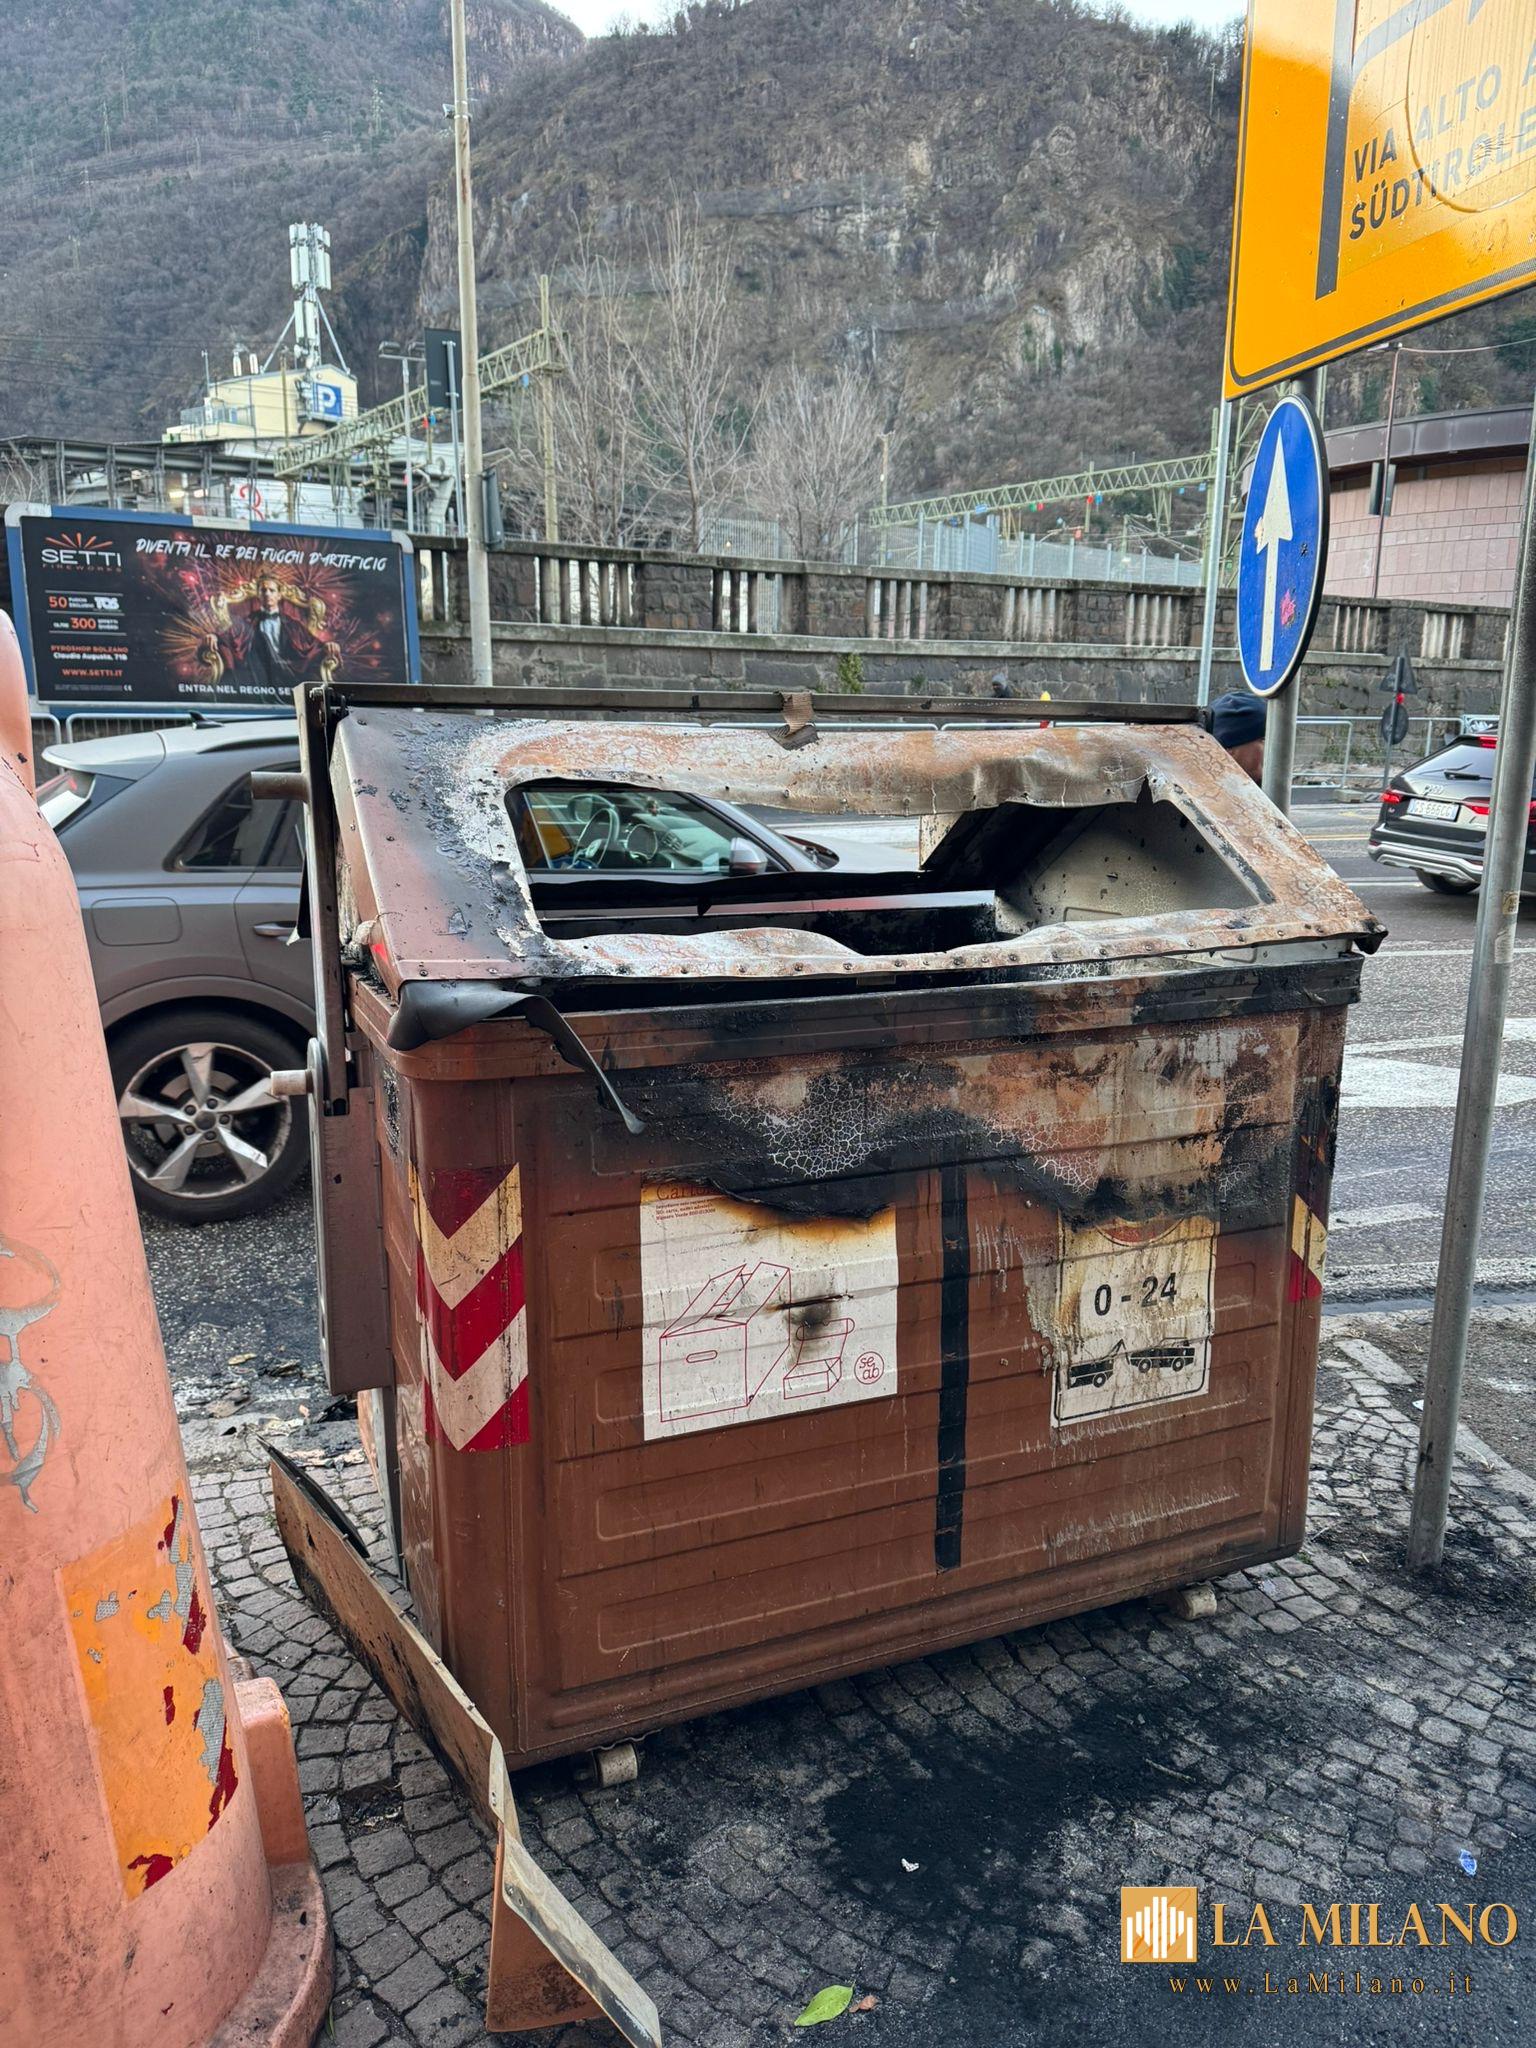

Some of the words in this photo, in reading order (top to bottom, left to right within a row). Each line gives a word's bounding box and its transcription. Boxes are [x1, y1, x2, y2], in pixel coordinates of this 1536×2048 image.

[1354, 128, 1397, 183] VIA
[1415, 64, 1502, 144] ALTO
[41, 549, 121, 567] SETTI
[136, 538, 191, 557] DIVENTA
[195, 544, 212, 558] IL
[215, 544, 234, 559] RE
[235, 546, 258, 560] DEI
[48, 595, 68, 608] 50
[70, 617, 97, 630] 300
[178, 684, 215, 693] ENTRA
[216, 684, 237, 694] NEL
[240, 686, 276, 695] REGNO
[1095, 1284, 1112, 1316] 0
[1141, 1272, 1177, 1308] 24
[859, 1356, 875, 1368] se
[862, 1362, 880, 1380] ab
